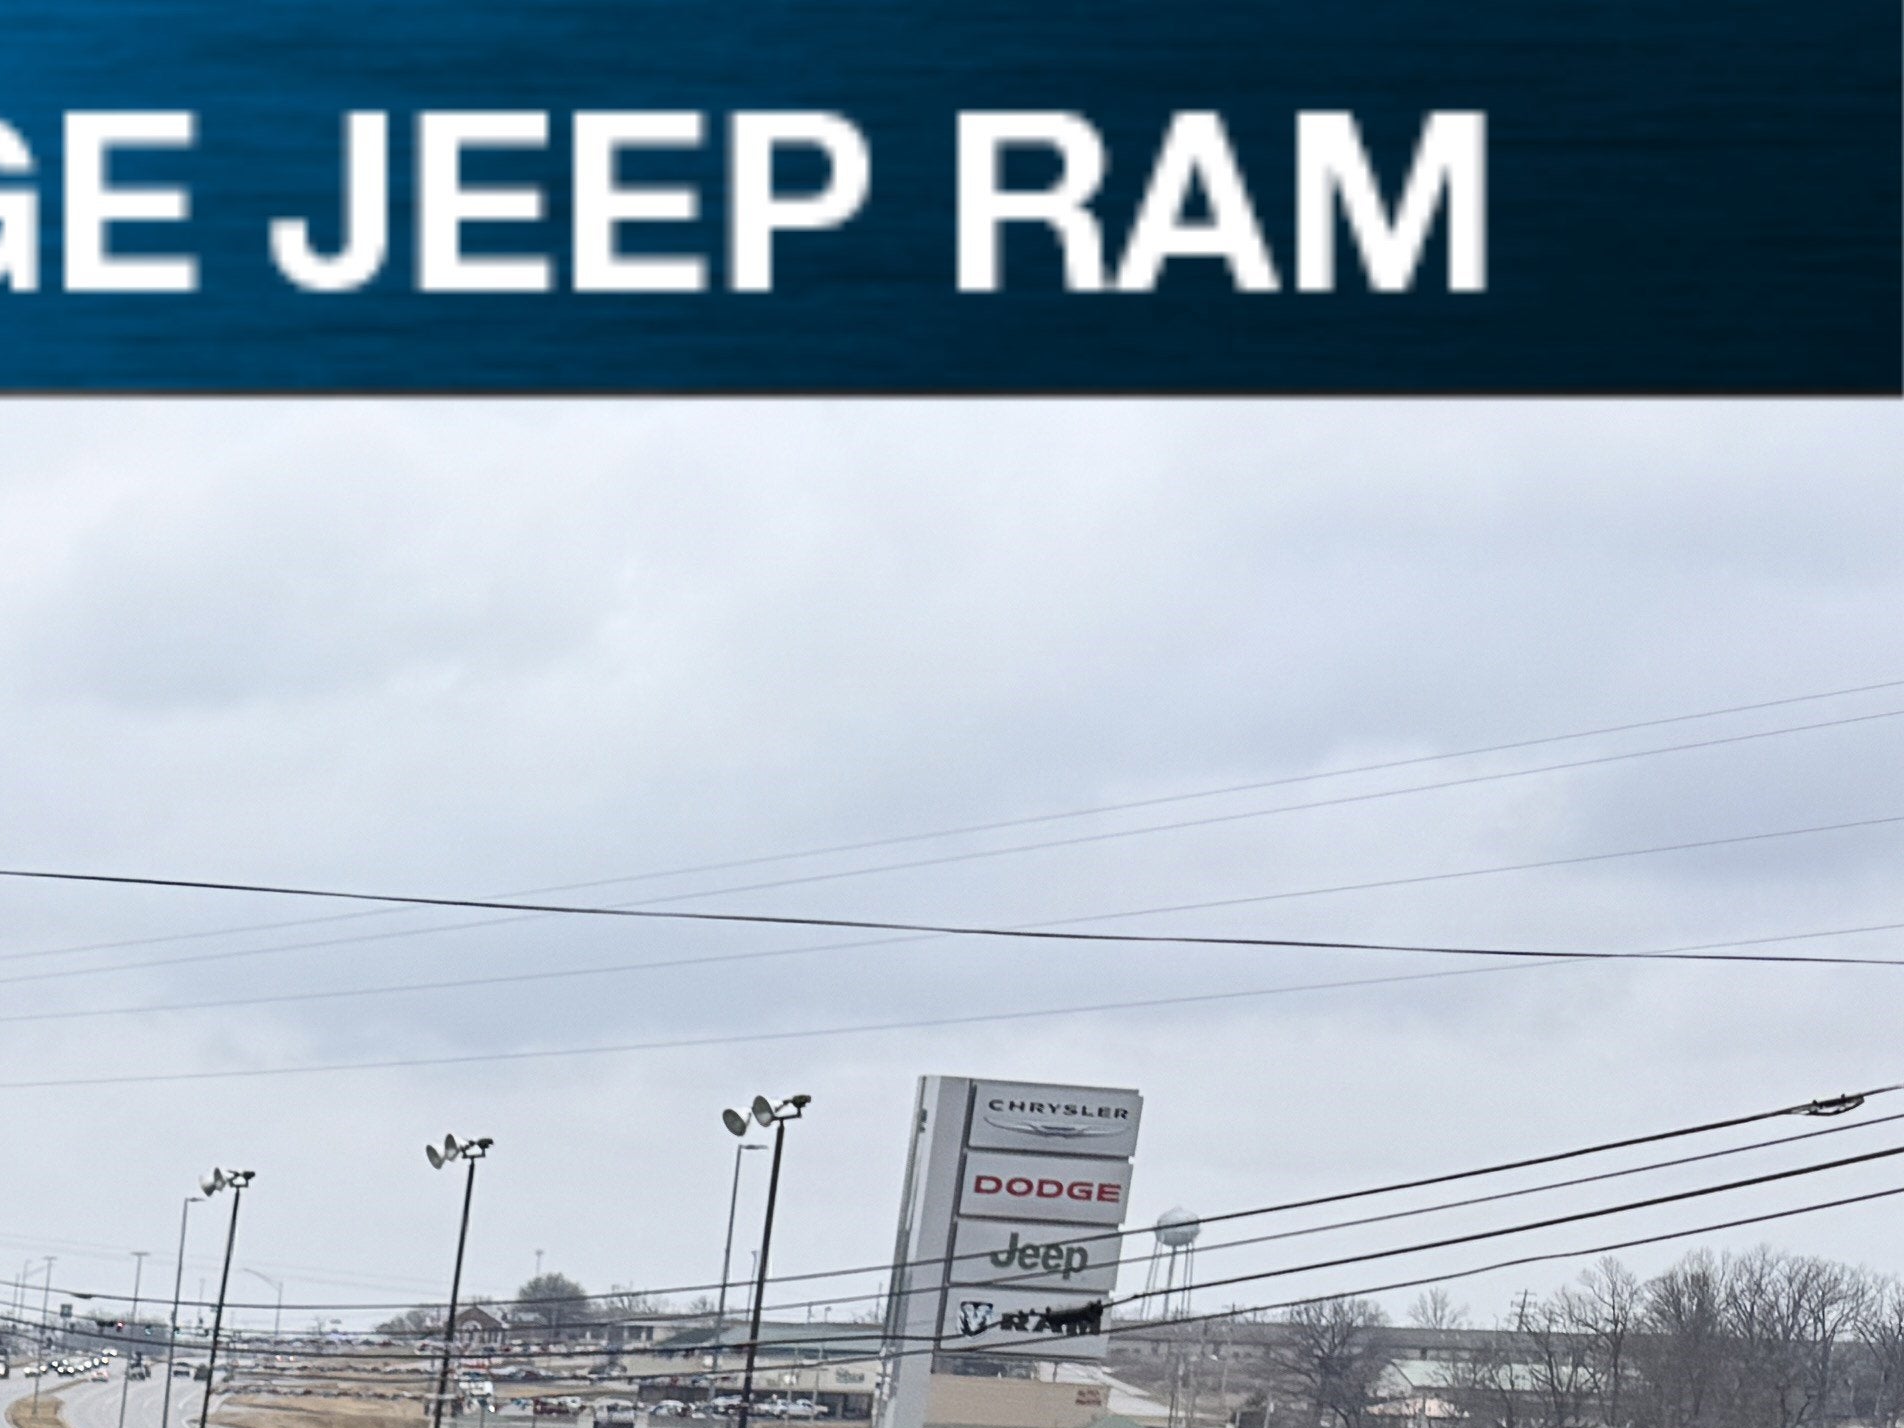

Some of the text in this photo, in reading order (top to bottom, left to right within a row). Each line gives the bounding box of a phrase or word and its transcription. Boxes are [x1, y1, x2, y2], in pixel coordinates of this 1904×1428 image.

[988, 1098, 1129, 1120] CHRYSLER
[974, 1175, 1122, 1203] DODGE
[990, 1232, 1089, 1280] Jeep
